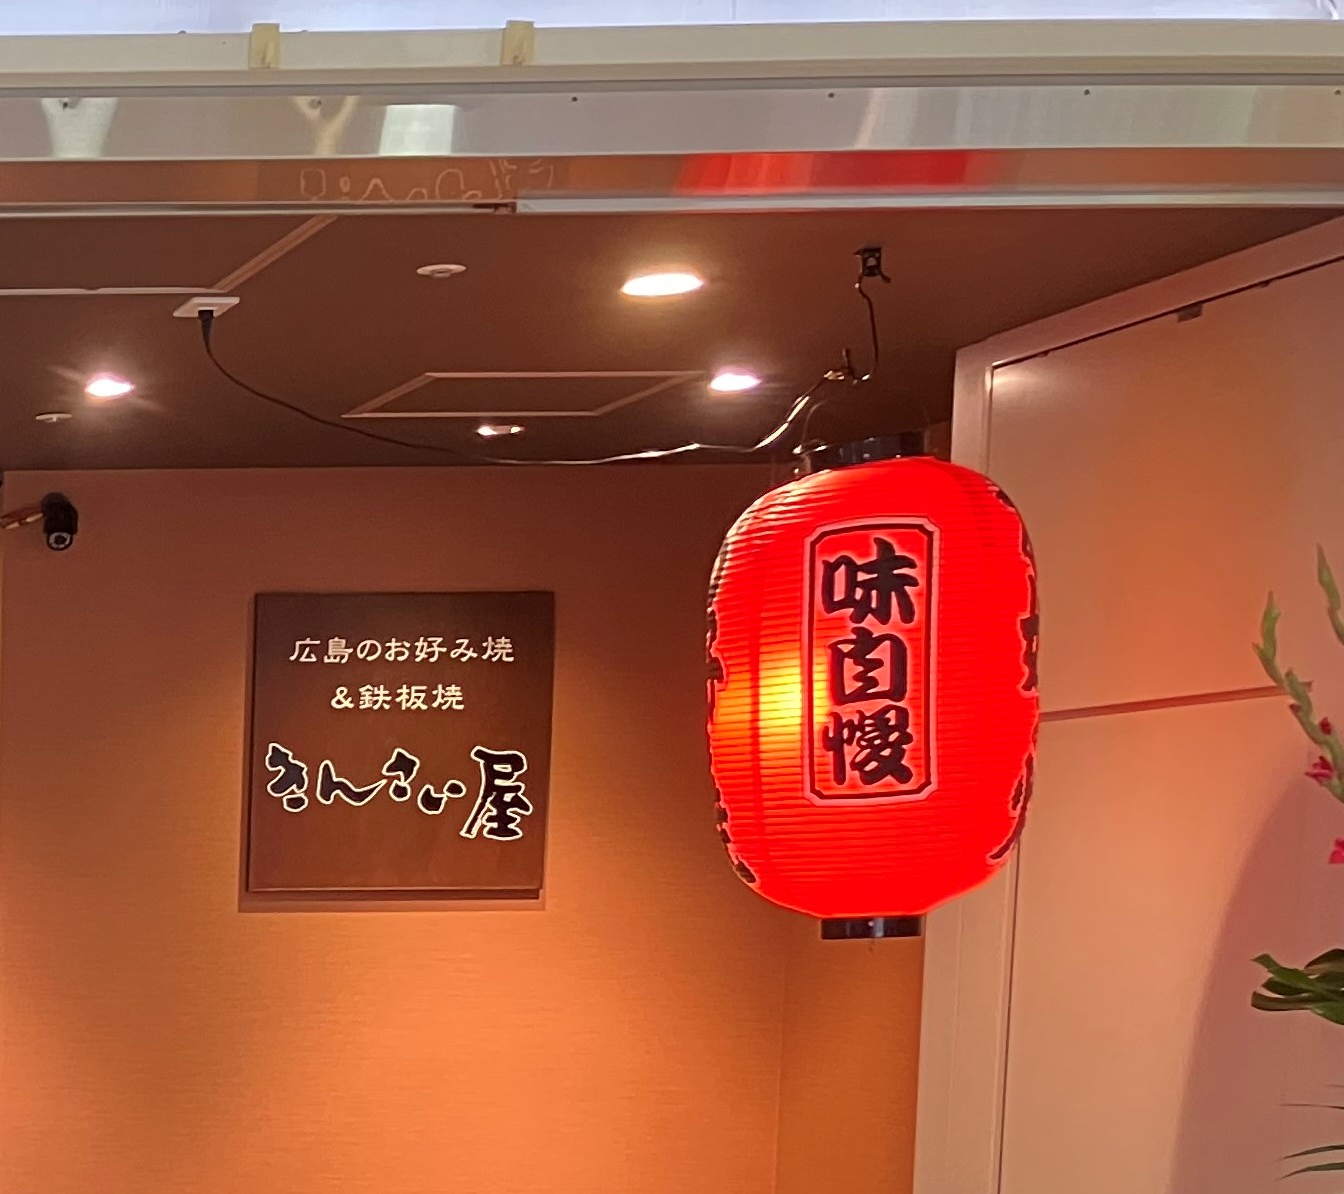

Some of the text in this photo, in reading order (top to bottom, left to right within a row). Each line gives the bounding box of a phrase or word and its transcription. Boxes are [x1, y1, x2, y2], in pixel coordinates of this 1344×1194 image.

[289, 636, 515, 664] 広島のお好み焼
[821, 536, 921, 787] 味自慢
[331, 684, 465, 710] &鉄板焼
